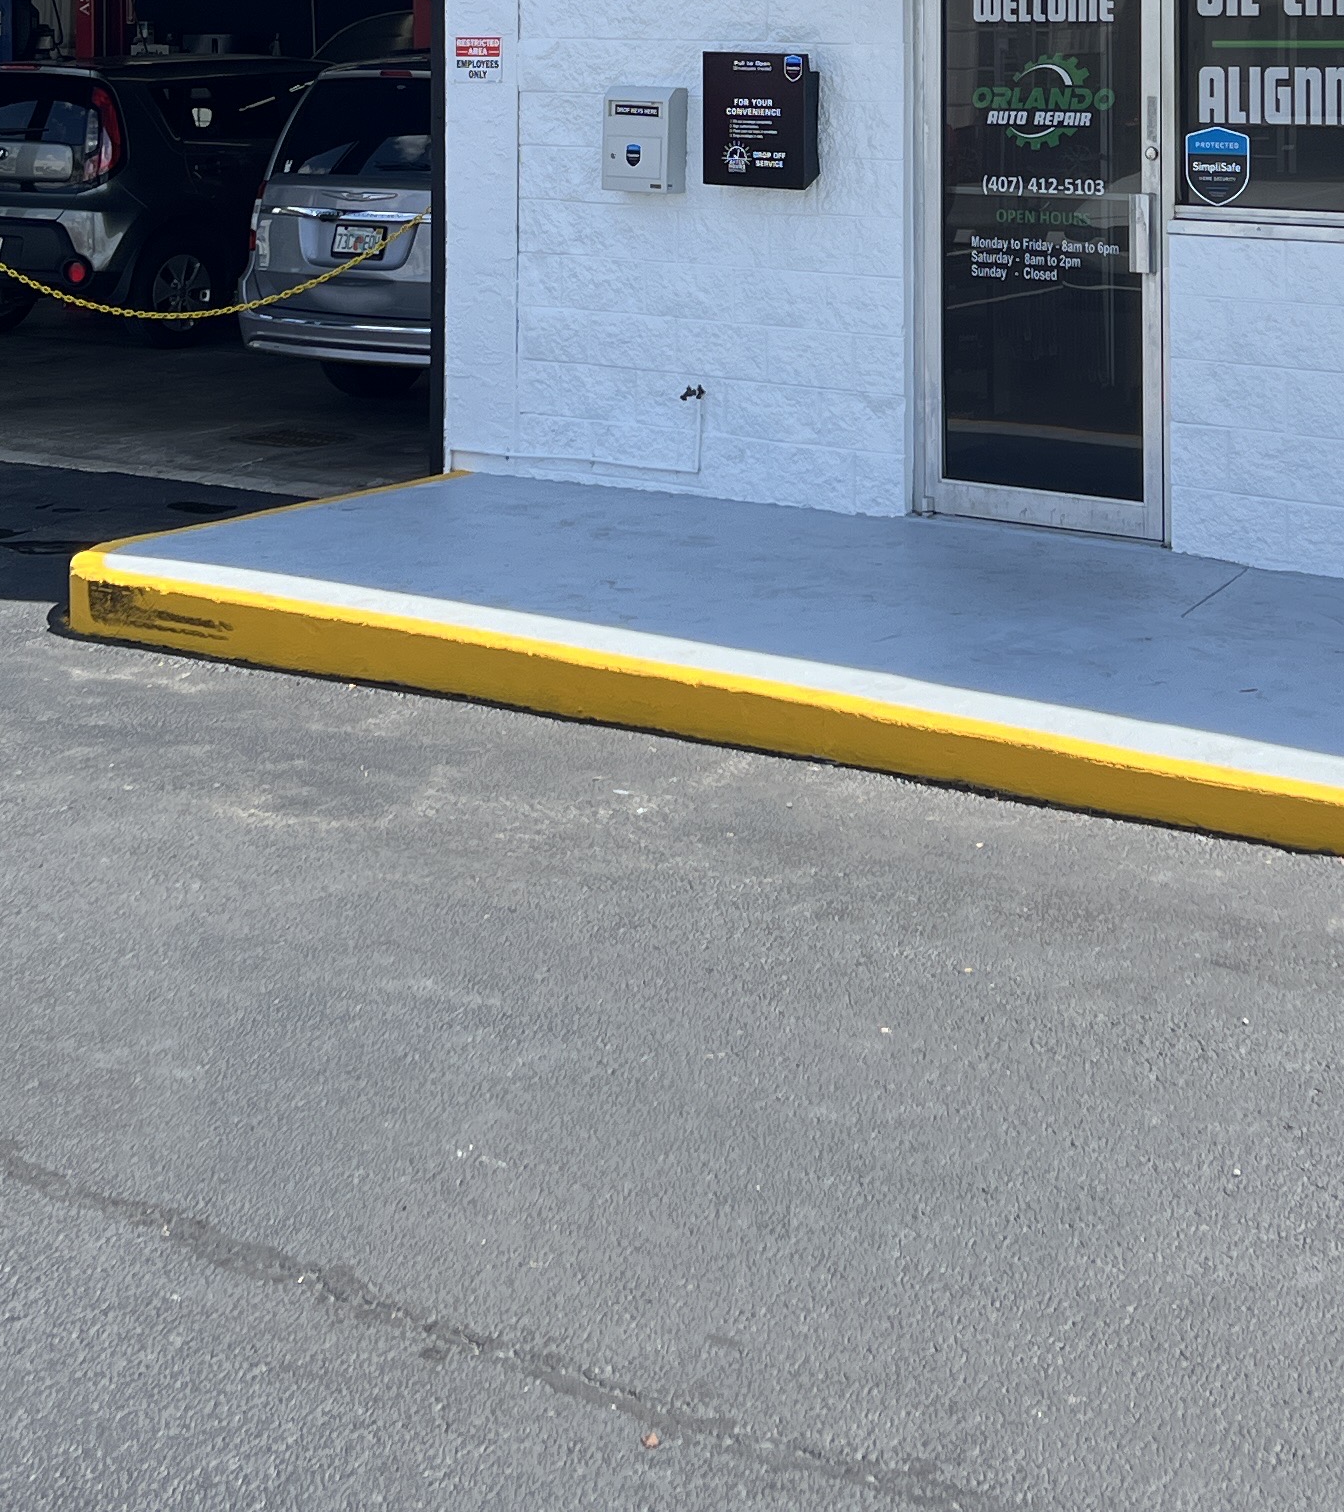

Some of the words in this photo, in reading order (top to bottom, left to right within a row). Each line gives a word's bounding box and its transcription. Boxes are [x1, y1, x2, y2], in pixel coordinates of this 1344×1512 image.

[468, 47, 487, 55] AREA
[457, 59, 499, 68] EMPLOYEES
[468, 70, 487, 79] ONLY
[734, 98, 749, 106] FOR
[751, 98, 773, 106] YOUR
[972, 87, 1115, 111] ORLANDO
[726, 107, 781, 116] CONVENIENCE
[987, 111, 1028, 125] AUTO
[1034, 111, 1092, 126] REPAIR
[1195, 141, 1240, 149] PROTECTED
[755, 160, 784, 168] SERVICE
[1192, 161, 1241, 173] SimpliSafe
[982, 175, 1023, 196] (407)
[1027, 177, 1105, 196] 412-5103
[996, 209, 1035, 224] OPEN
[1040, 210, 1091, 226] HOURS
[971, 235, 1008, 250] Monday
[1011, 237, 1020, 248] to
[1023, 238, 1054, 254] Friday
[1061, 241, 1083, 253] 8am
[1085, 241, 1095, 253] to
[1097, 242, 1120, 257] 6pm
[971, 250, 1014, 266] Saturday
[1024, 253, 1046, 266] 8am
[1047, 254, 1058, 266] to
[1059, 255, 1081, 269] 2pm
[971, 265, 1007, 280] Sunday
[1023, 267, 1058, 281] Closed
